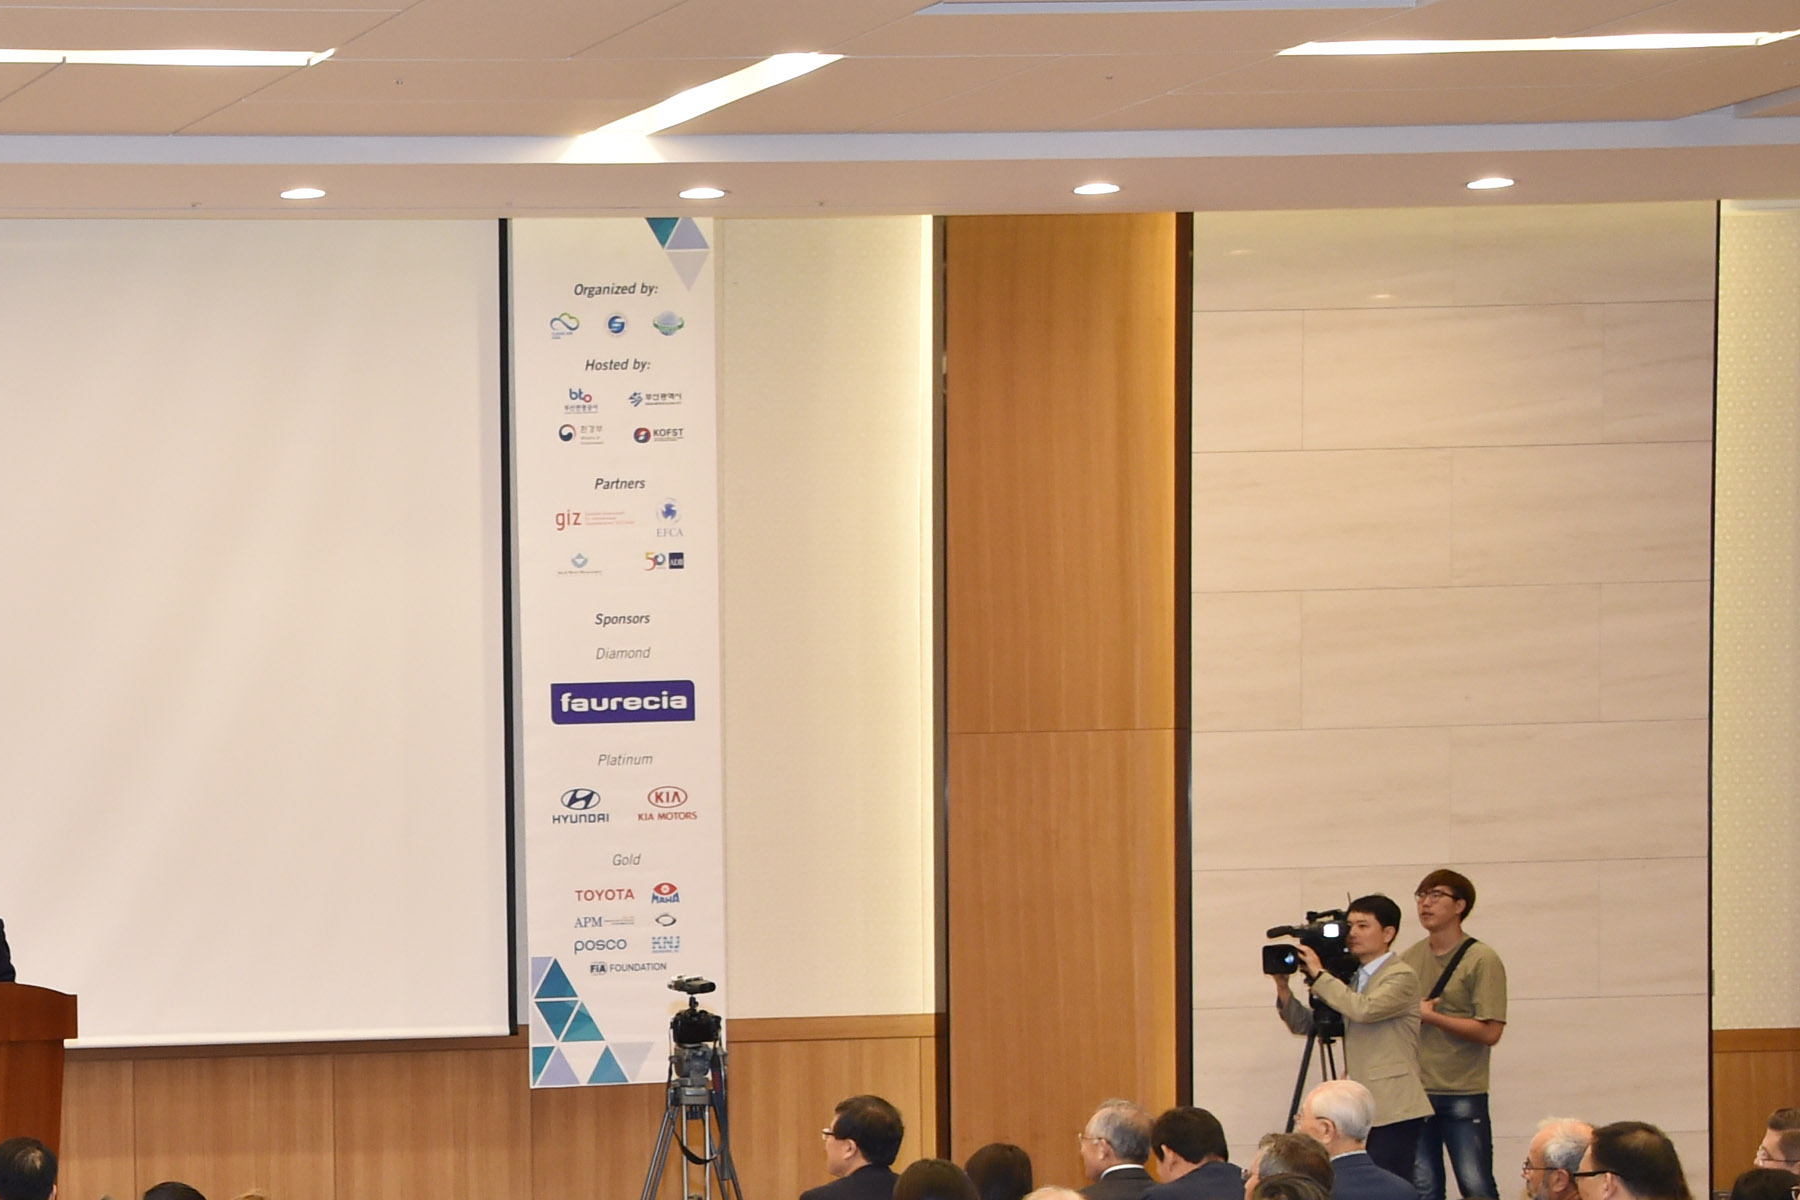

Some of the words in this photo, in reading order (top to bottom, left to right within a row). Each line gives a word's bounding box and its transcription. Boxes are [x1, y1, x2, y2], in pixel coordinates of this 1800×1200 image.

[574, 283, 637, 298] Organized
[640, 282, 658, 296] by:
[585, 358, 629, 371] Hosted
[633, 358, 651, 372] by:
[569, 388, 592, 403] bto
[653, 428, 684, 437] KOFST
[594, 477, 646, 490] Partners
[555, 509, 581, 531] giz
[656, 528, 683, 537] EFCA
[594, 613, 651, 627] Sponsors
[595, 647, 651, 660] Diamond
[560, 690, 687, 712] faurecia
[598, 753, 653, 766] Platinum
[654, 791, 681, 803] KIA
[552, 813, 609, 824] HYUNDAI
[638, 813, 654, 821] KIA
[657, 811, 698, 821] MOTORS
[612, 853, 641, 866] Gold
[574, 889, 635, 901] TOYOTA
[651, 892, 680, 904] MAHA
[574, 916, 603, 928] APM
[574, 939, 627, 955] posco
[609, 962, 667, 972] FOUNDATION
